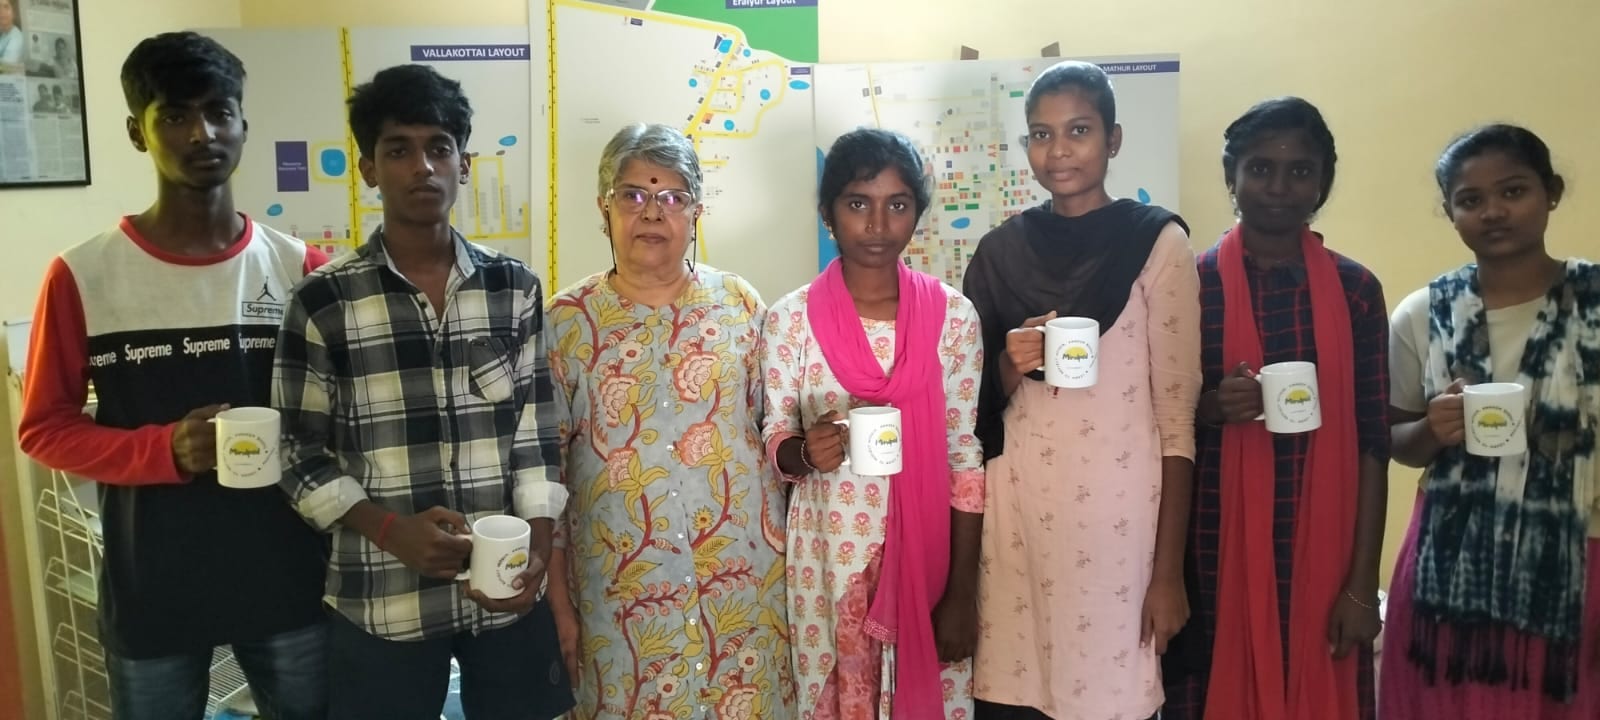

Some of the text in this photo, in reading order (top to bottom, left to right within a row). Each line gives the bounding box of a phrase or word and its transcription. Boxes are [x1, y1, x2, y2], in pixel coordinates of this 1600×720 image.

[422, 48, 525, 58] VALLAKOTTAI LAYOUT
[124, 343, 173, 365] Supreme
[183, 337, 230, 358] Supreme
